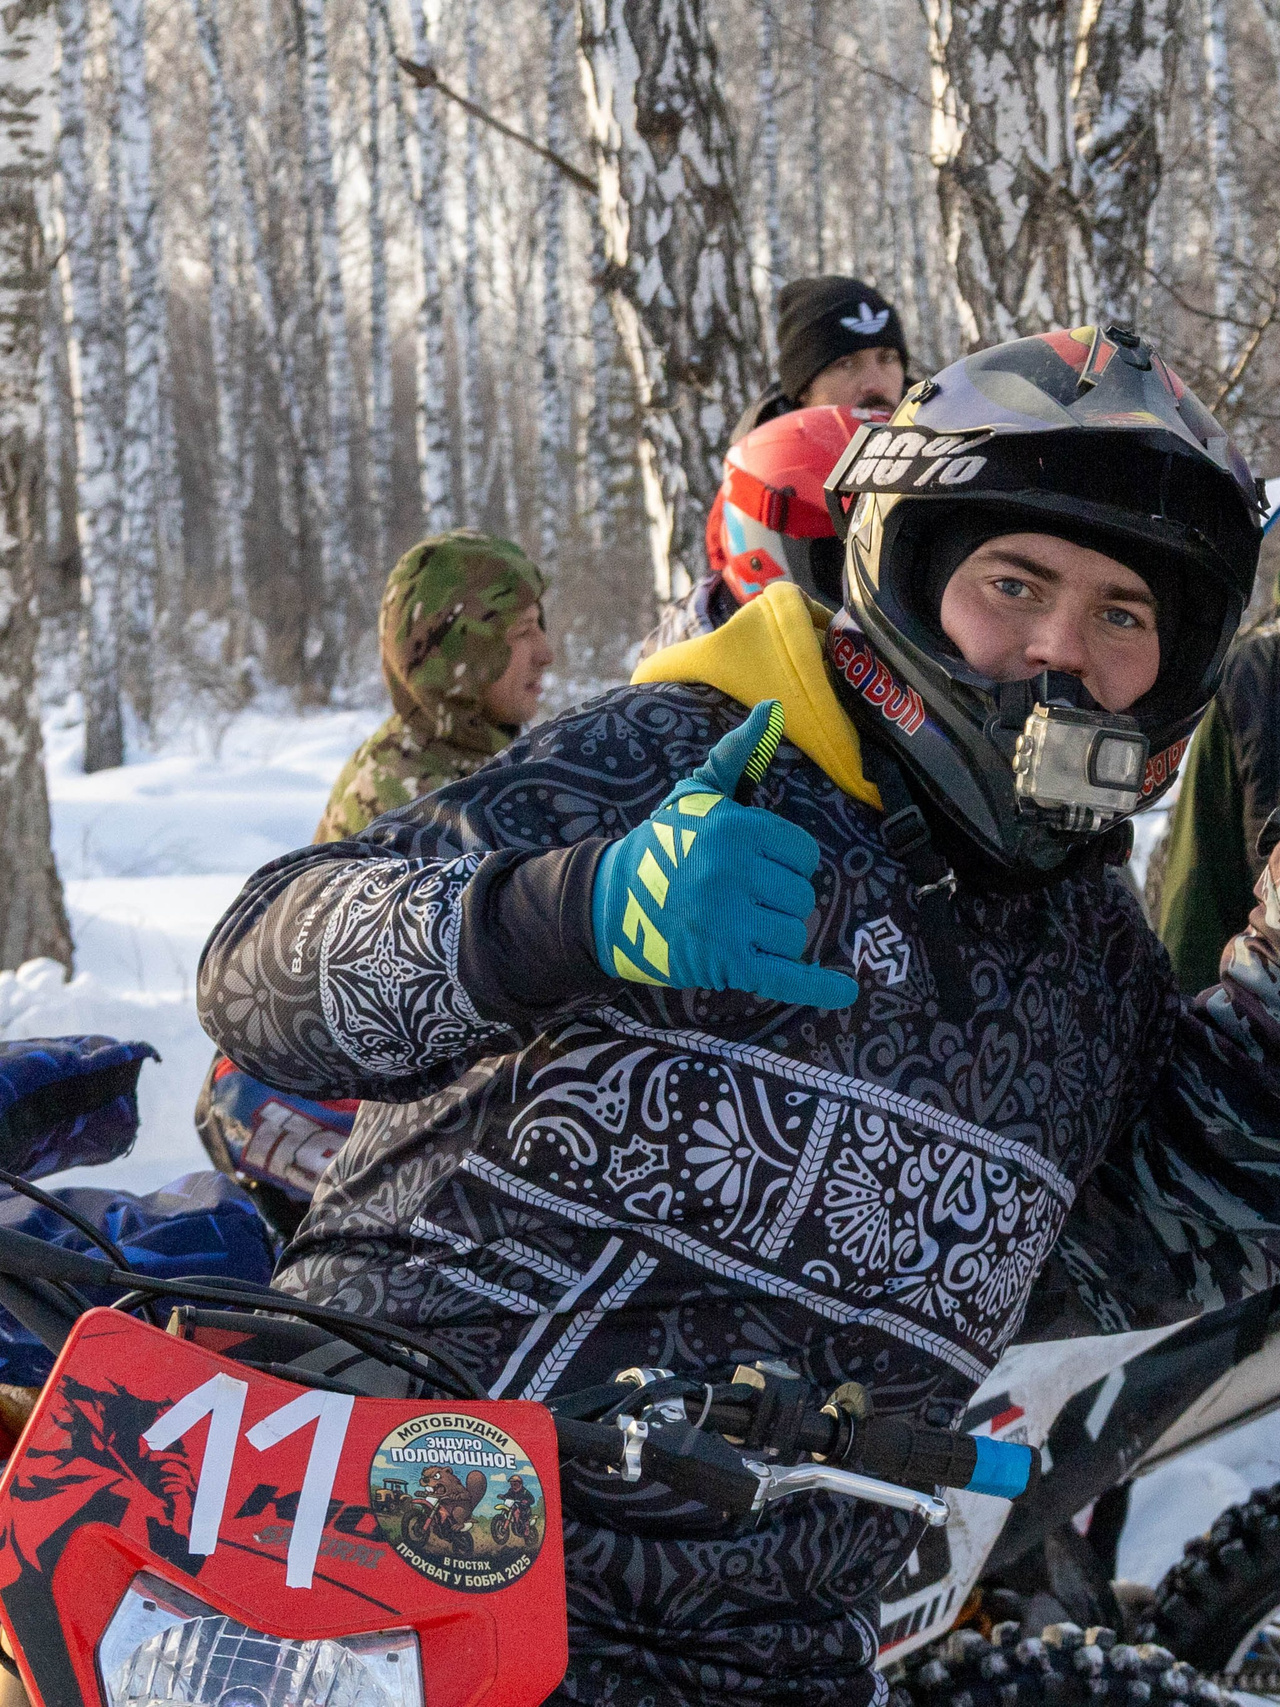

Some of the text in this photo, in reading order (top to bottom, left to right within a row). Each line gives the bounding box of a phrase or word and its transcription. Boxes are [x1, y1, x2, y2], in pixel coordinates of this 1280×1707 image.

[291, 903, 322, 974] BATIK
[397, 1416, 509, 1448] МОТОБЛУДНИ
[425, 1437, 482, 1451] ЭНДУРО
[390, 1447, 517, 1469] ПОЛОМОШНОЕ
[142, 1371, 355, 1589] 11
[396, 1542, 531, 1588] ПРОХВАТ У БОБРА 2025
[443, 1556, 491, 1571] В ГОСТЯХ
